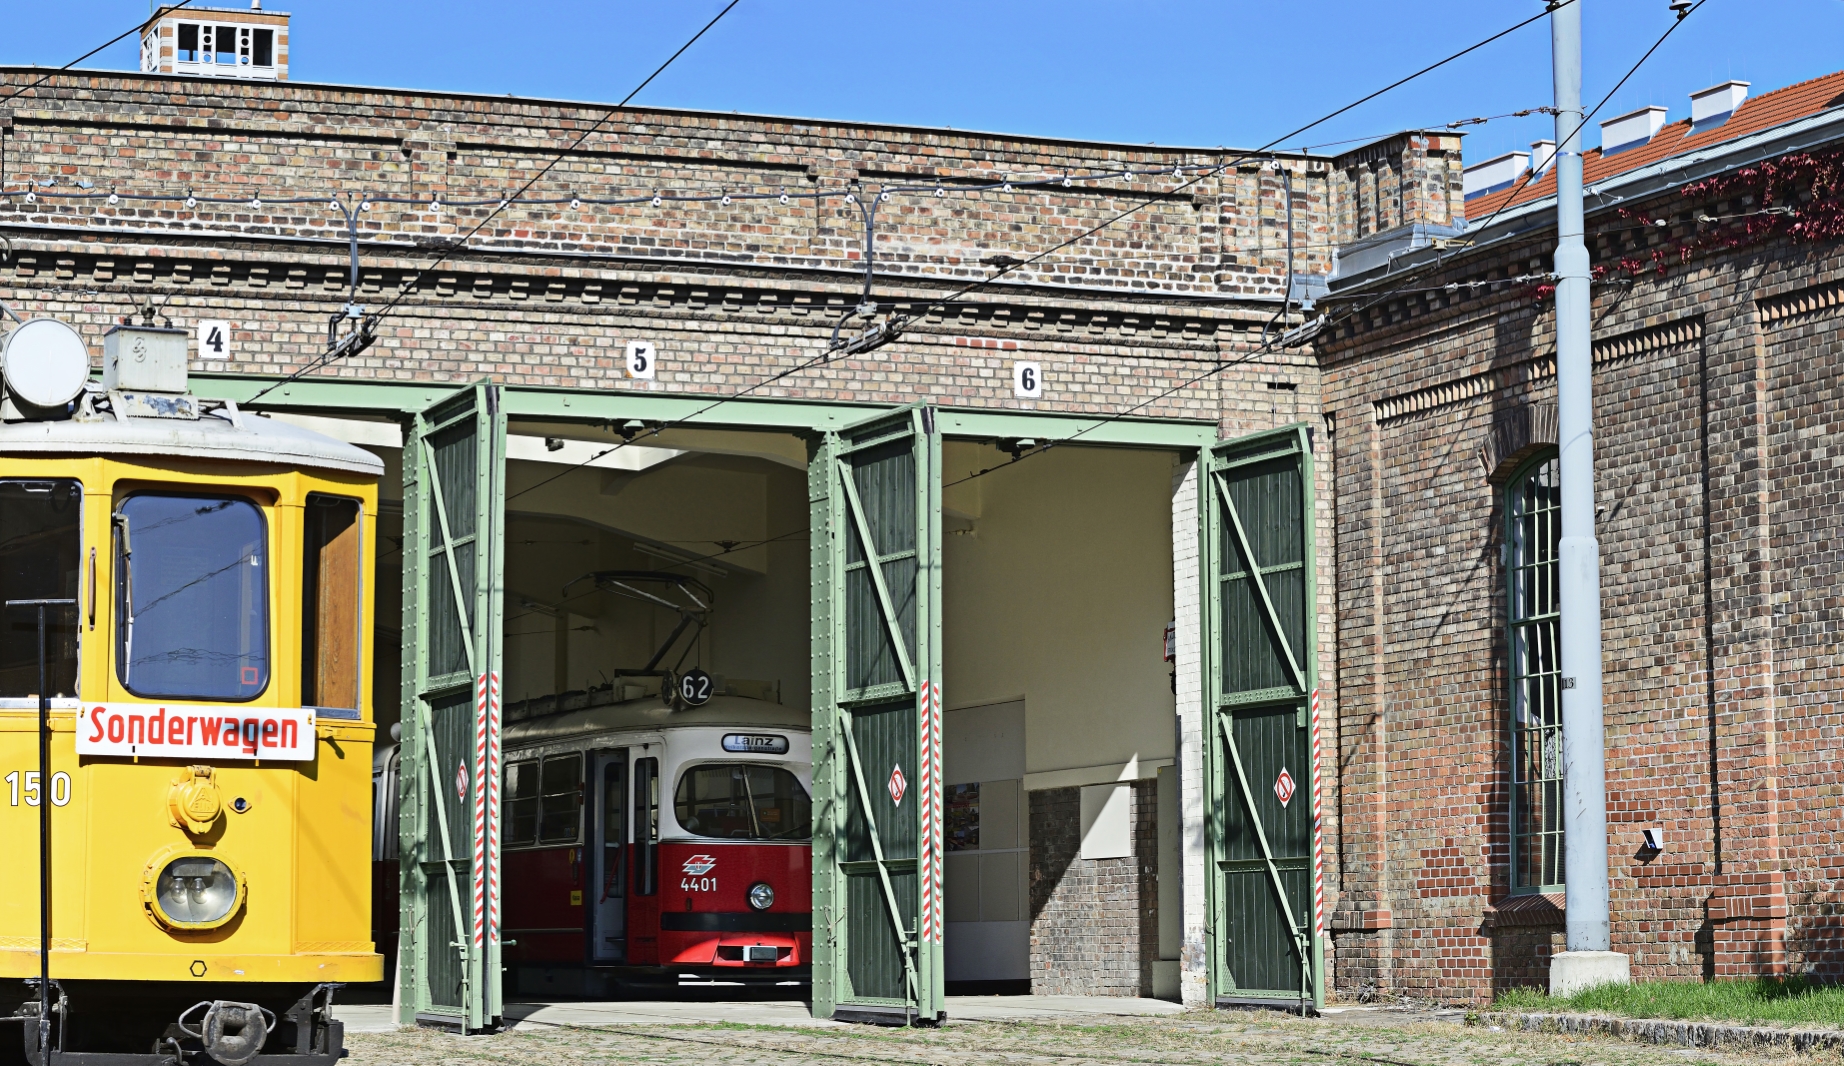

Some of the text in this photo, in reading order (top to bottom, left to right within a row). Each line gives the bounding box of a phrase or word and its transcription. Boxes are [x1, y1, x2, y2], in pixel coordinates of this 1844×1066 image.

[206, 326, 223, 352] 4
[633, 347, 647, 372] 5
[1022, 367, 1035, 391] 6
[682, 676, 709, 698] 62
[89, 706, 298, 754] Sonderwagen
[734, 735, 773, 746] Lainz
[680, 877, 716, 891] 4401
